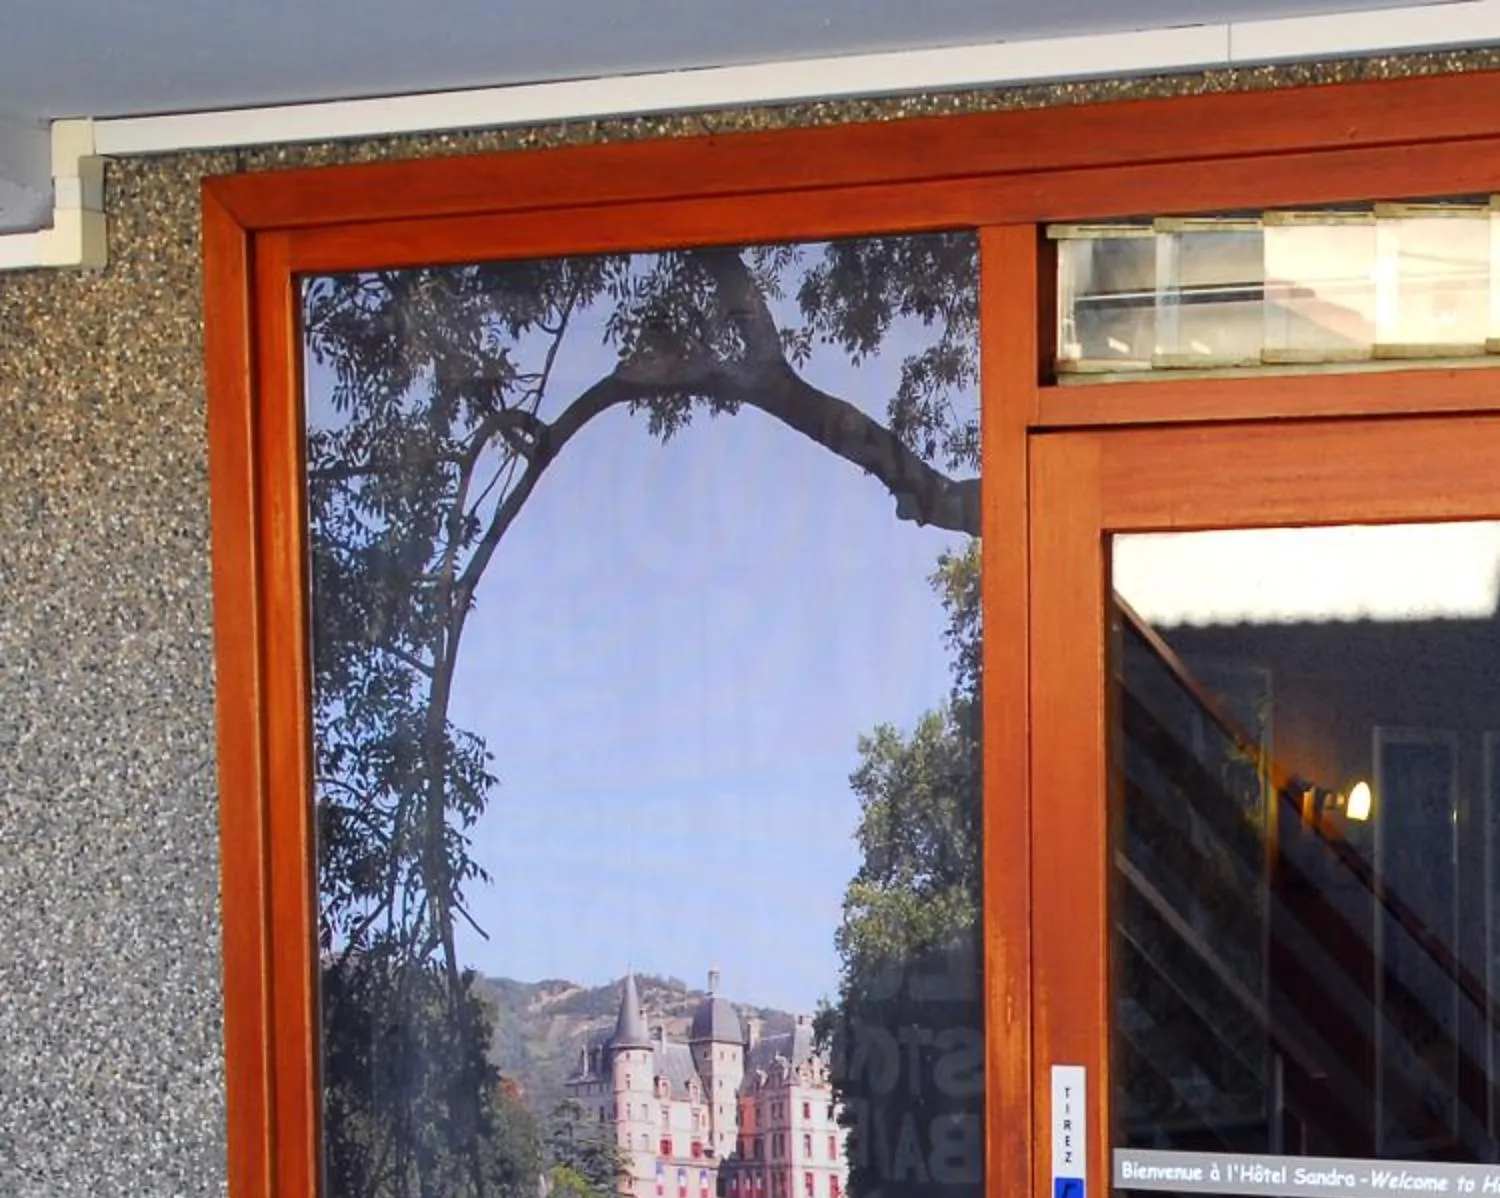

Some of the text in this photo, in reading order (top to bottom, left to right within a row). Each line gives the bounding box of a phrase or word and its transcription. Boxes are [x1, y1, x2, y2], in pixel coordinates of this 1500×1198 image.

[1062, 1086, 1074, 1164] TIREZ
[1121, 1160, 1203, 1181] Bienvenue
[1209, 1162, 1221, 1181] à
[1227, 1164, 1287, 1185] l'Hôtel
[1293, 1167, 1357, 1188] Sandra
[1370, 1169, 1448, 1192] Welcome
[1456, 1176, 1475, 1194] to
